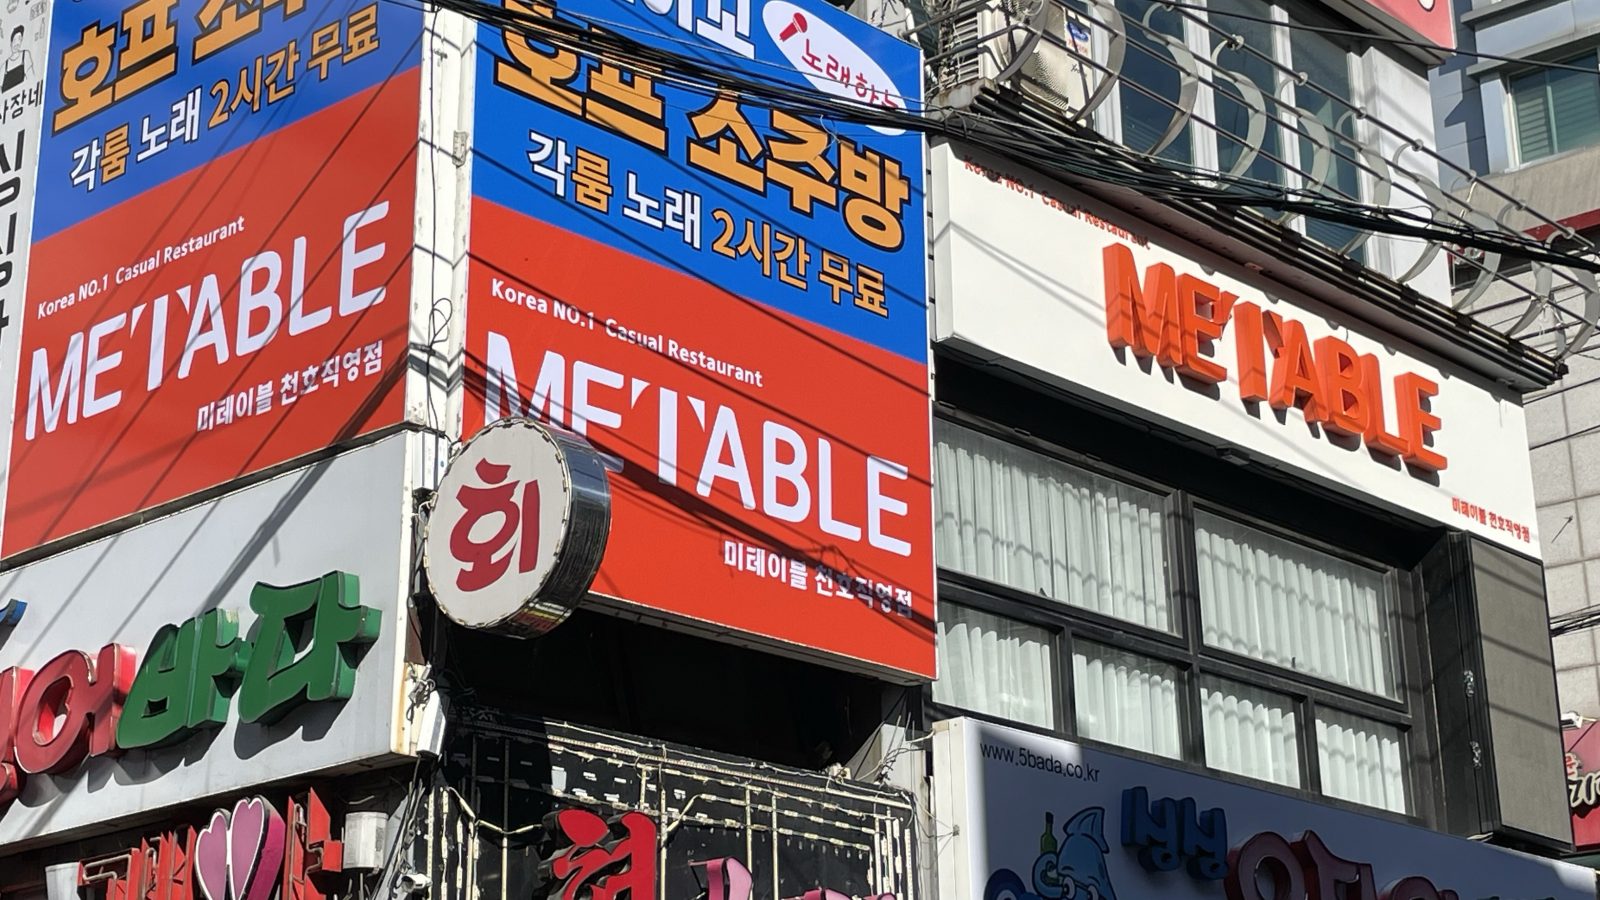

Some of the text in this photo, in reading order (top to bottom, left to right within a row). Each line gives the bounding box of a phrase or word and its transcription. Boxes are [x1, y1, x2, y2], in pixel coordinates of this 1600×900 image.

[53, 0, 177, 135] 호프
[70, 5, 380, 192] 각룸 노래 2시간 무료
[495, 0, 908, 250] 호프 소주방
[37, 216, 245, 320] Korea NO.1 Casual Restaurant
[527, 129, 889, 319] 각룸 노래 2시간 무료
[25, 201, 390, 441] METABLE
[197, 340, 383, 431] 미테이블 천호직영점
[491, 278, 764, 388] Korea NO.1 Casual Restaurant
[1103, 242, 1447, 470] METABLE
[484, 331, 911, 557] METABLE
[450, 457, 540, 592] 회
[724, 540, 912, 618] 미테이블 천호직영점
[980, 743, 1100, 782] www.5bada.co.kr
